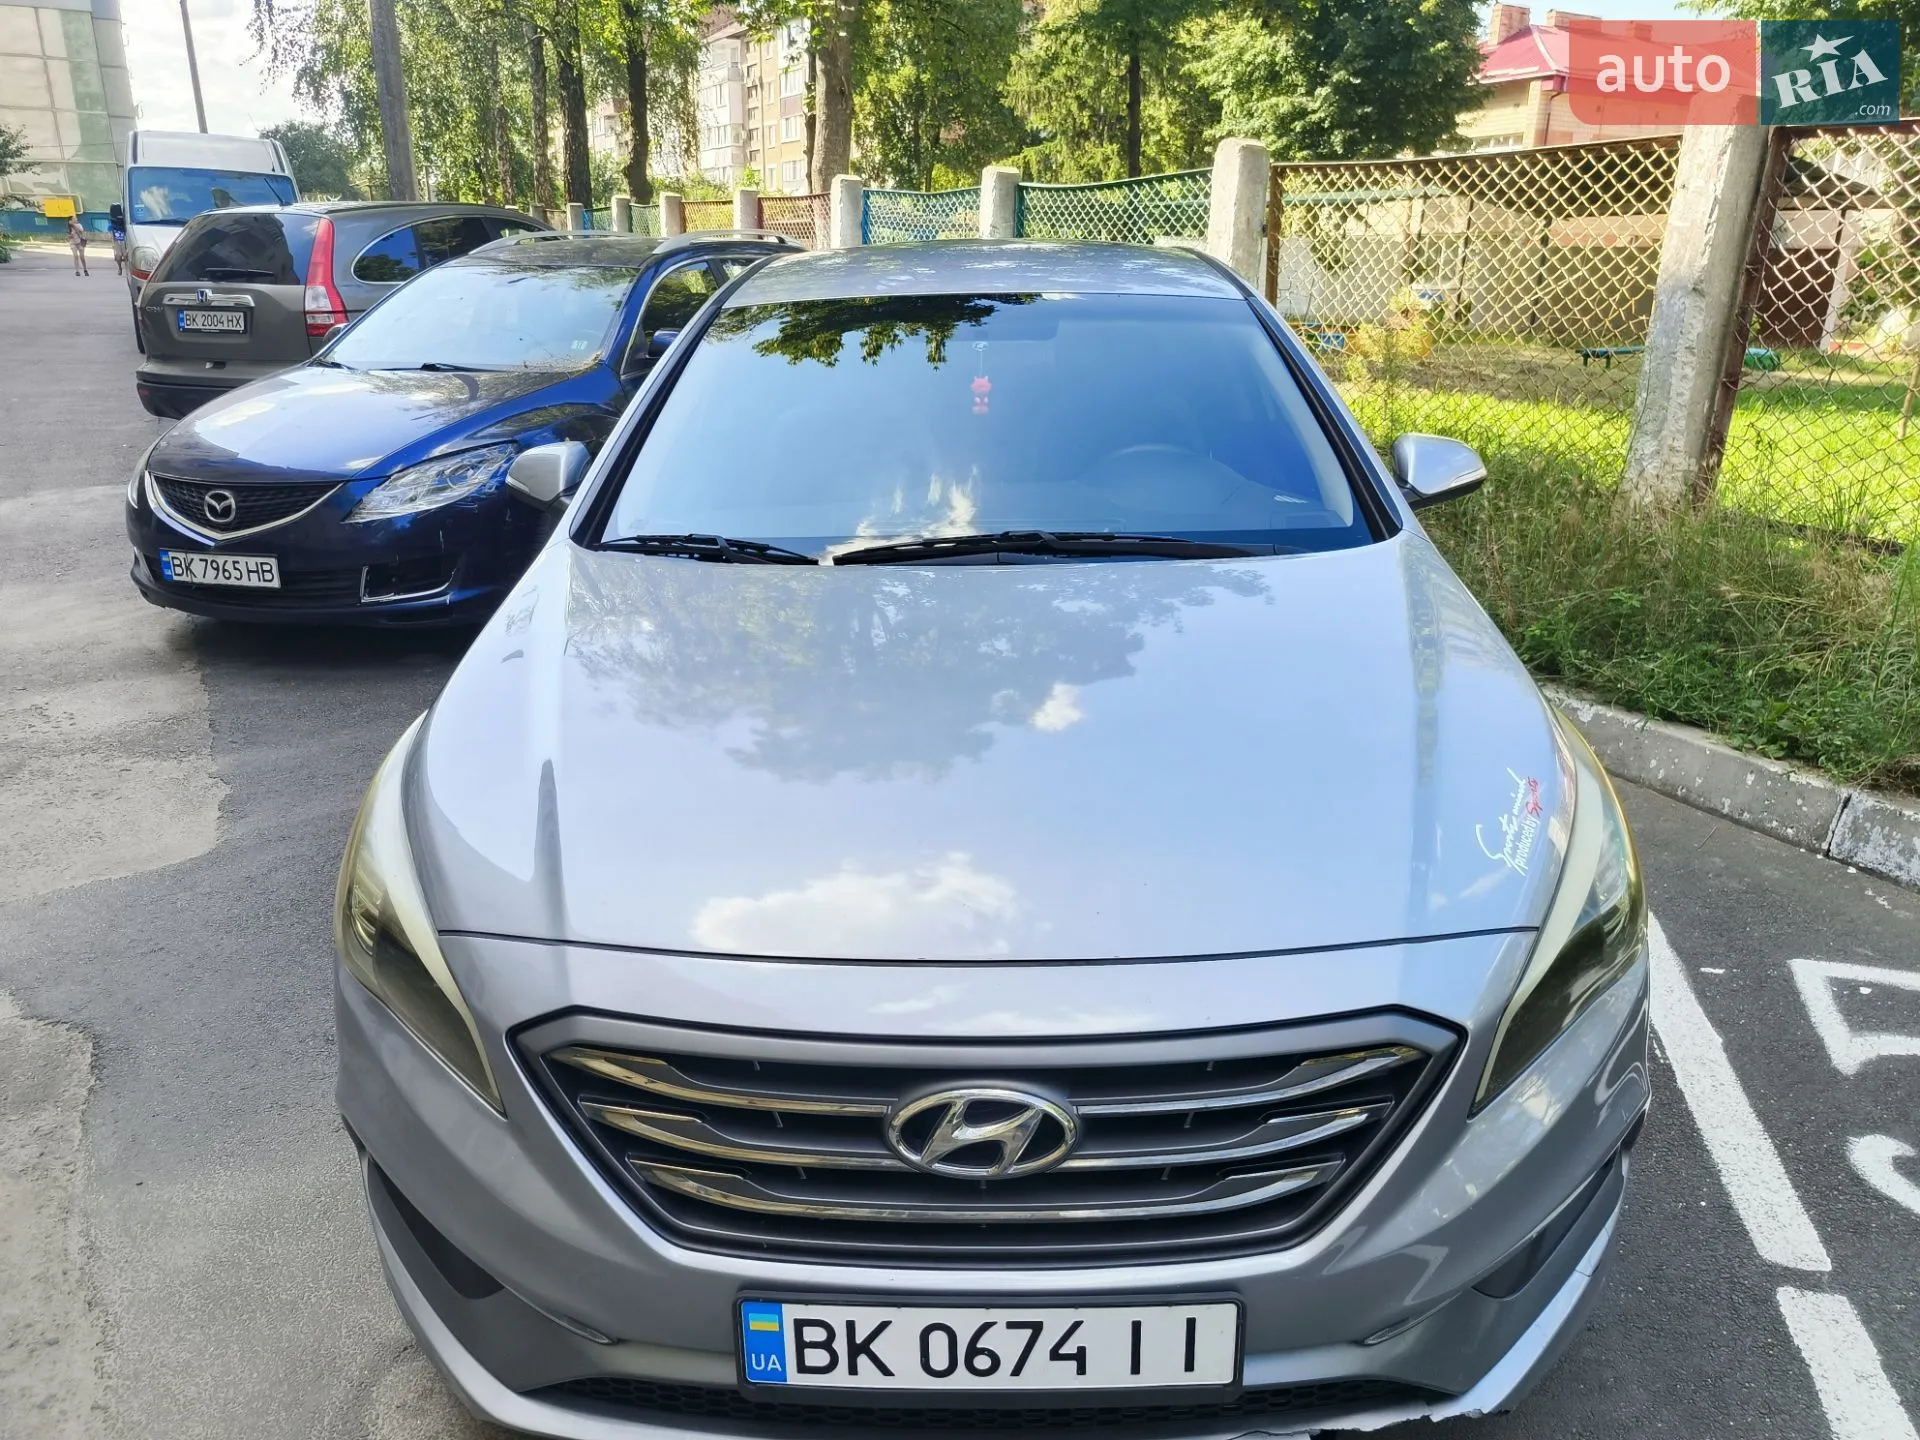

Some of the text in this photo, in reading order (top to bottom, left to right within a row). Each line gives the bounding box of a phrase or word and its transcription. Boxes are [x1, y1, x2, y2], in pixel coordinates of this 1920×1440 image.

[185, 313, 199, 327] BK
[201, 314, 225, 328] 2004
[227, 315, 242, 328] HX
[171, 556, 275, 582] BK 7965 HB
[793, 1318, 896, 1377] BK
[919, 1320, 1087, 1379] 0674
[752, 1353, 782, 1371] UA
